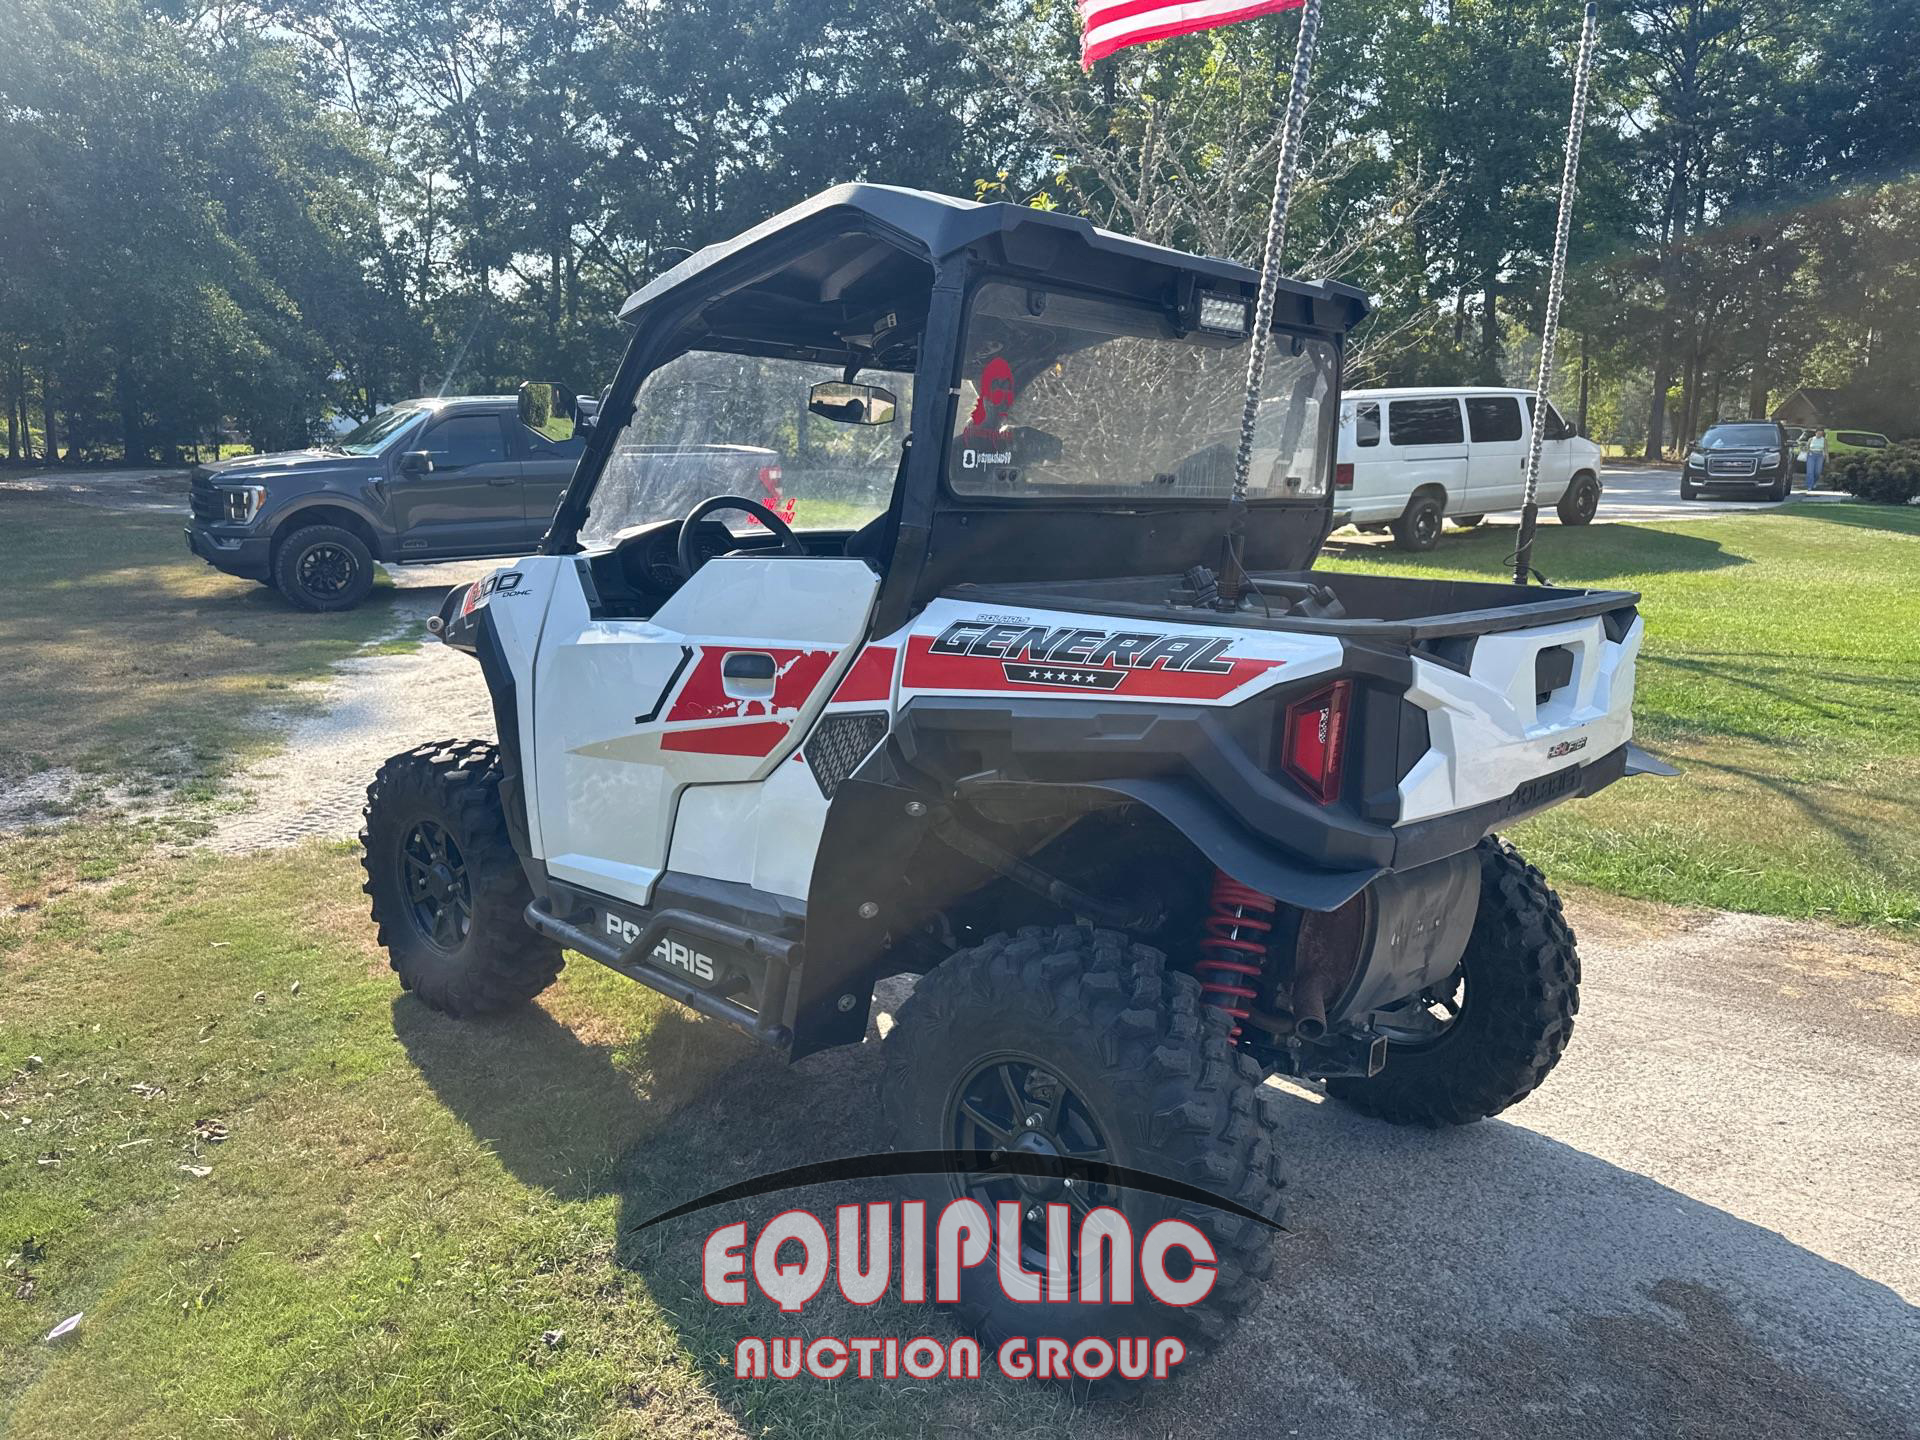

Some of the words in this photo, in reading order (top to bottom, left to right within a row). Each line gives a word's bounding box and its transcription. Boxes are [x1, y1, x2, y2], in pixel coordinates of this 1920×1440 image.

[503, 588, 533, 598] DOHC
[974, 613, 1030, 623] POLARIS
[927, 620, 1236, 675] GENERAL
[606, 912, 714, 981] POARIS
